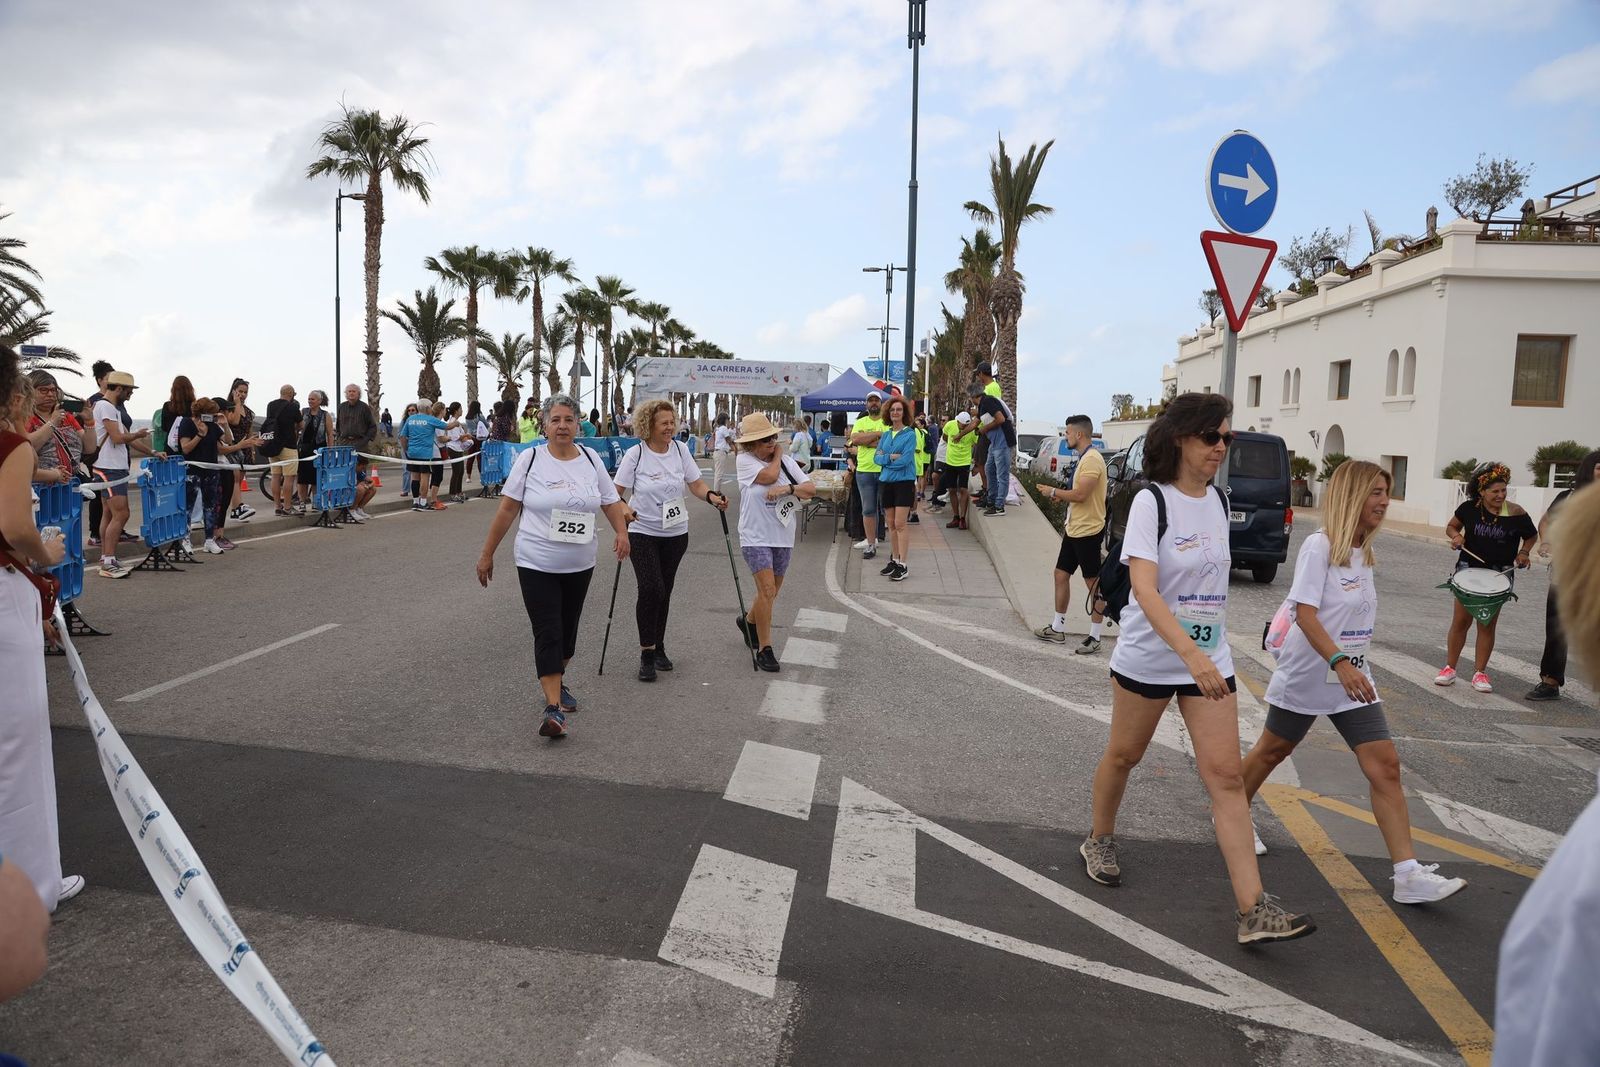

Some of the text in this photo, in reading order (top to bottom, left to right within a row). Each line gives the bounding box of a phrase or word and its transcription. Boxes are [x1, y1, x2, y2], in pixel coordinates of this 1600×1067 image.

[710, 364, 753, 373] CARRERA
[754, 366, 767, 374] 5K
[780, 501, 794, 517] 550
[558, 521, 586, 535] 252
[1189, 624, 1212, 642] 33
